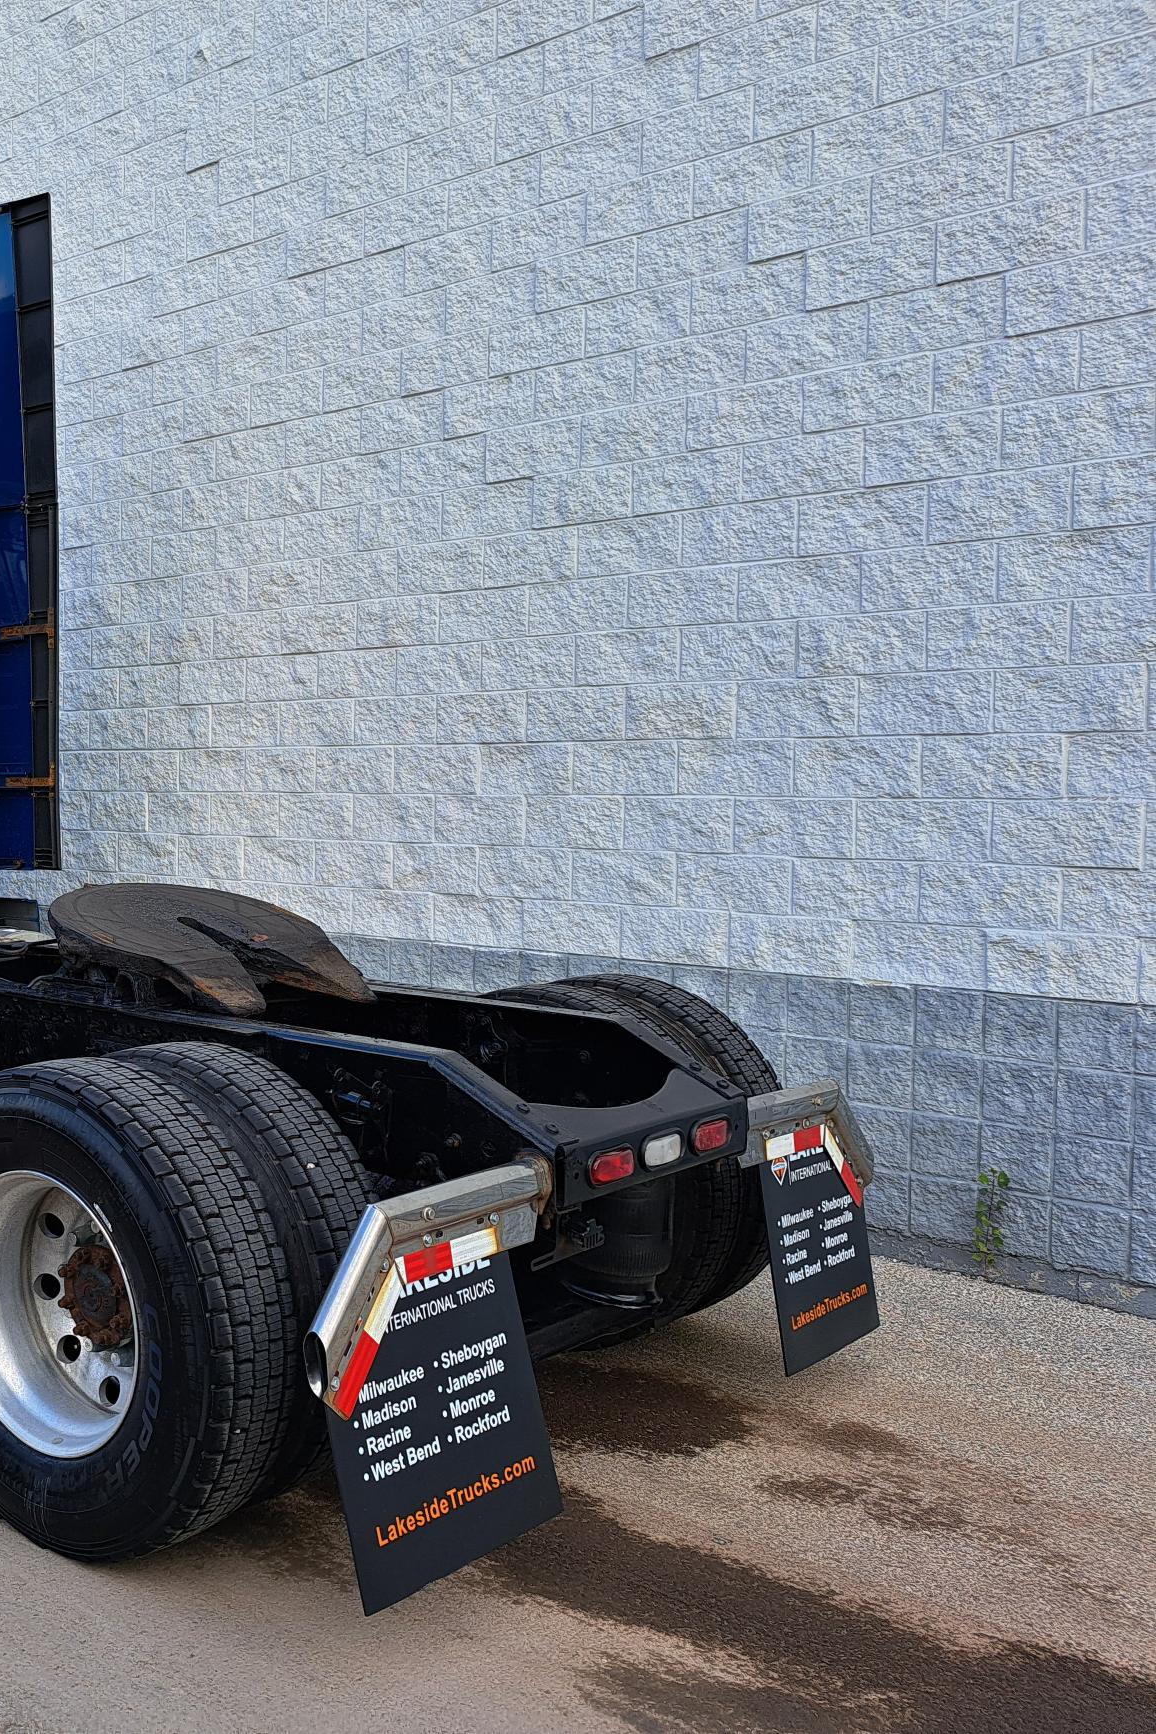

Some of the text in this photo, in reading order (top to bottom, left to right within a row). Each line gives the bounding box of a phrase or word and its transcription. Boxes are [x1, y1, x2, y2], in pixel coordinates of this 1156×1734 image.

[790, 1159, 833, 1183] INTERNATIONAL
[780, 1207, 815, 1229] Milwaukee
[820, 1193, 854, 1213] Sheboyga
[783, 1227, 811, 1247] Madison
[823, 1210, 854, 1232] Janesville
[785, 1248, 808, 1267] Racine
[825, 1232, 849, 1250] Monroe
[827, 1244, 856, 1268] Rockford
[787, 1259, 822, 1286] West Bend
[385, 1278, 497, 1334] TERNATIONAL TRUCKS
[791, 1282, 869, 1332] LakesideTrucks.com
[440, 1330, 508, 1370] Sheboygan
[358, 1363, 425, 1404] Milwaukee
[445, 1357, 505, 1395] Janesville
[105, 1302, 164, 1488] COOPER
[449, 1387, 497, 1420] Monroe
[361, 1394, 418, 1431] Madison
[454, 1405, 512, 1445] Rockford
[365, 1425, 413, 1457] Racine
[370, 1435, 442, 1483] West Bend
[374, 1453, 537, 1549] LakesideTrucks.com
